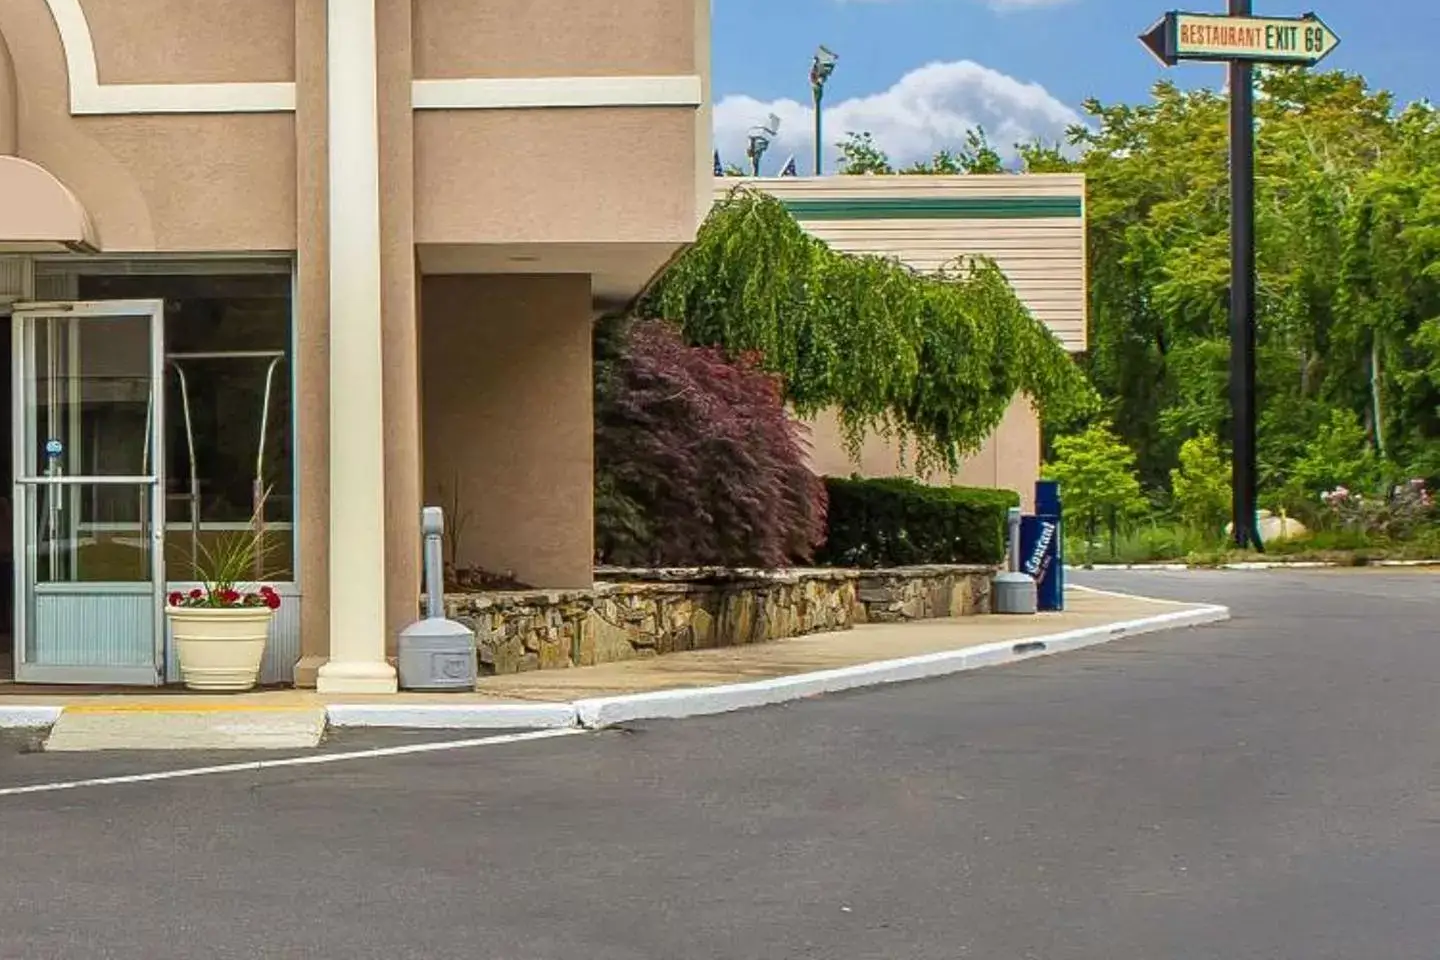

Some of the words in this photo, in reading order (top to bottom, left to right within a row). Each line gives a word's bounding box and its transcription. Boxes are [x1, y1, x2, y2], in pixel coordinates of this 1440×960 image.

[1181, 24, 1262, 48] RESTAURANT
[1265, 25, 1297, 50] EXIT
[1304, 27, 1323, 52] 69
